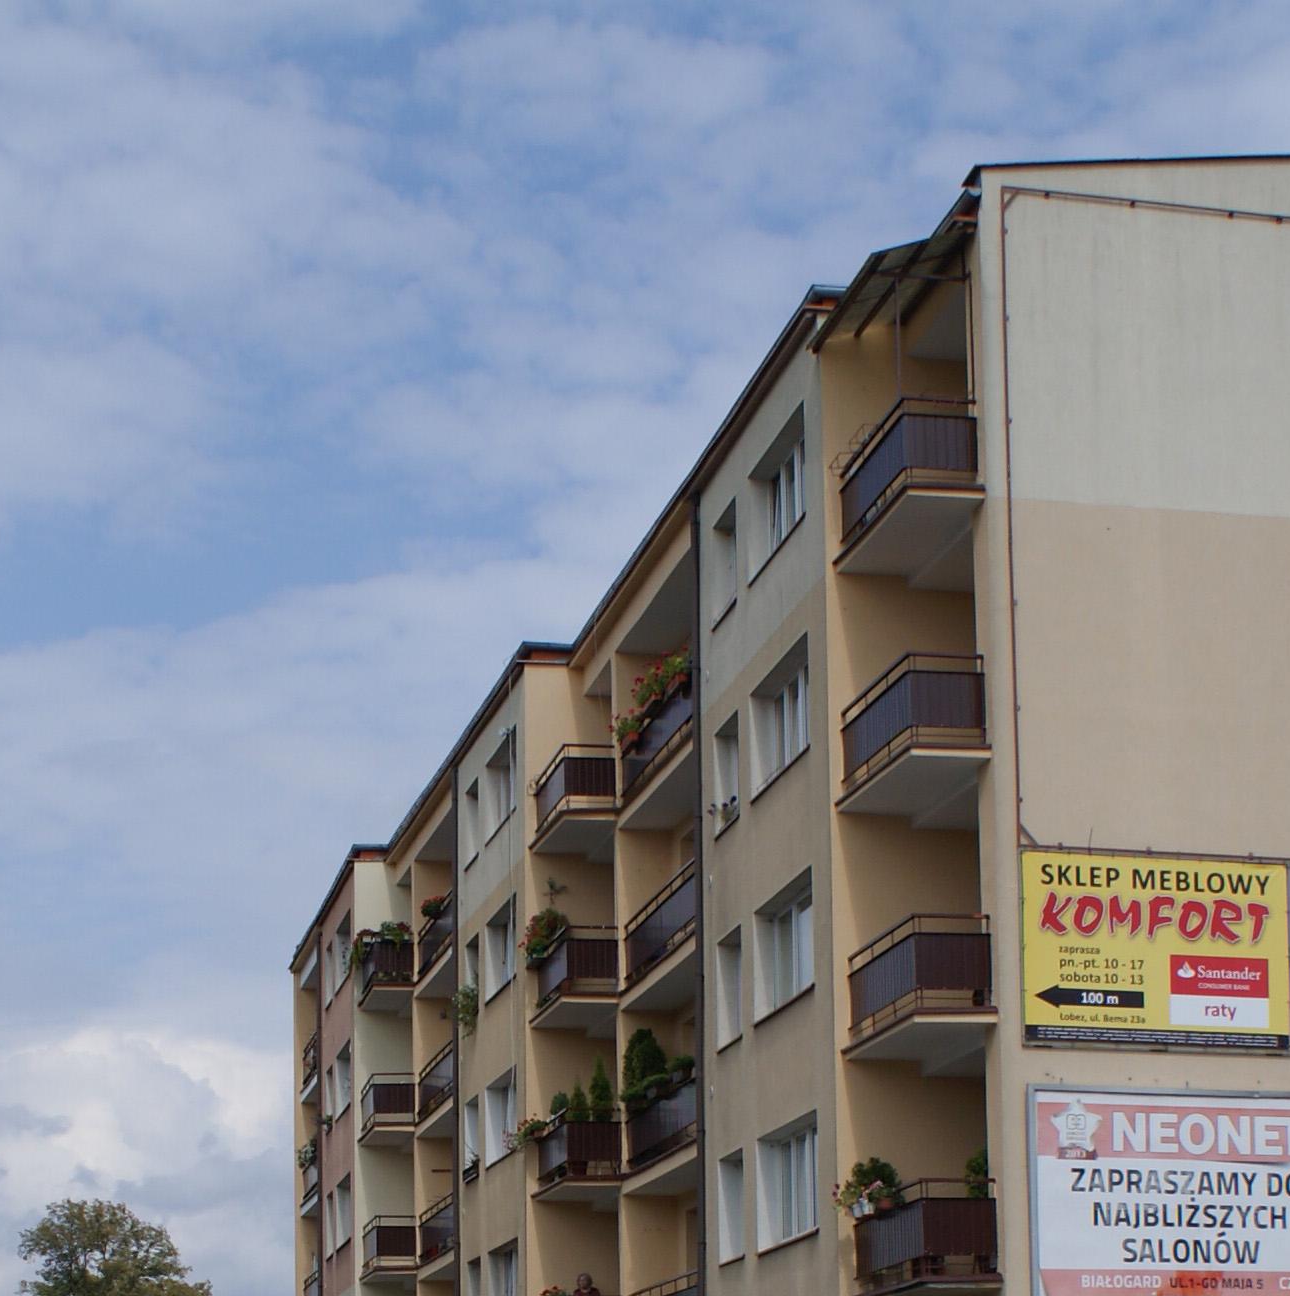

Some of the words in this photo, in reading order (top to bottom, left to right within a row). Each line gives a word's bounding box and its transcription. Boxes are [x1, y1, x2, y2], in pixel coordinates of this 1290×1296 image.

[1040, 863, 1120, 888] SKLEP
[1131, 868, 1270, 896] MEBLOWY
[1039, 890, 1270, 945] KOMFORT
[1059, 946, 1100, 955] zaprasza
[1059, 959, 1100, 970] pn.-pt.
[1104, 959, 1118, 970] 10
[1130, 960, 1144, 970] 17
[1197, 965, 1262, 980] Santander
[1059, 972, 1101, 983] sobota
[1104, 973, 1118, 984] 10
[1130, 974, 1144, 985] 13
[1080, 992, 1104, 1004] 100
[1106, 995, 1119, 1005] m
[1204, 1004, 1237, 1021] raty
[1070, 1167, 1257, 1196] ZAPRASZAMY
[1092, 1197, 1288, 1230] NAJBLIŻSZYCH
[1122, 1231, 1261, 1265] SALONÓW
[1081, 1274, 1162, 1289] BIAŁOGARD
[1221, 1278, 1253, 1289] MAJA
[1256, 1278, 1264, 1289] 5
